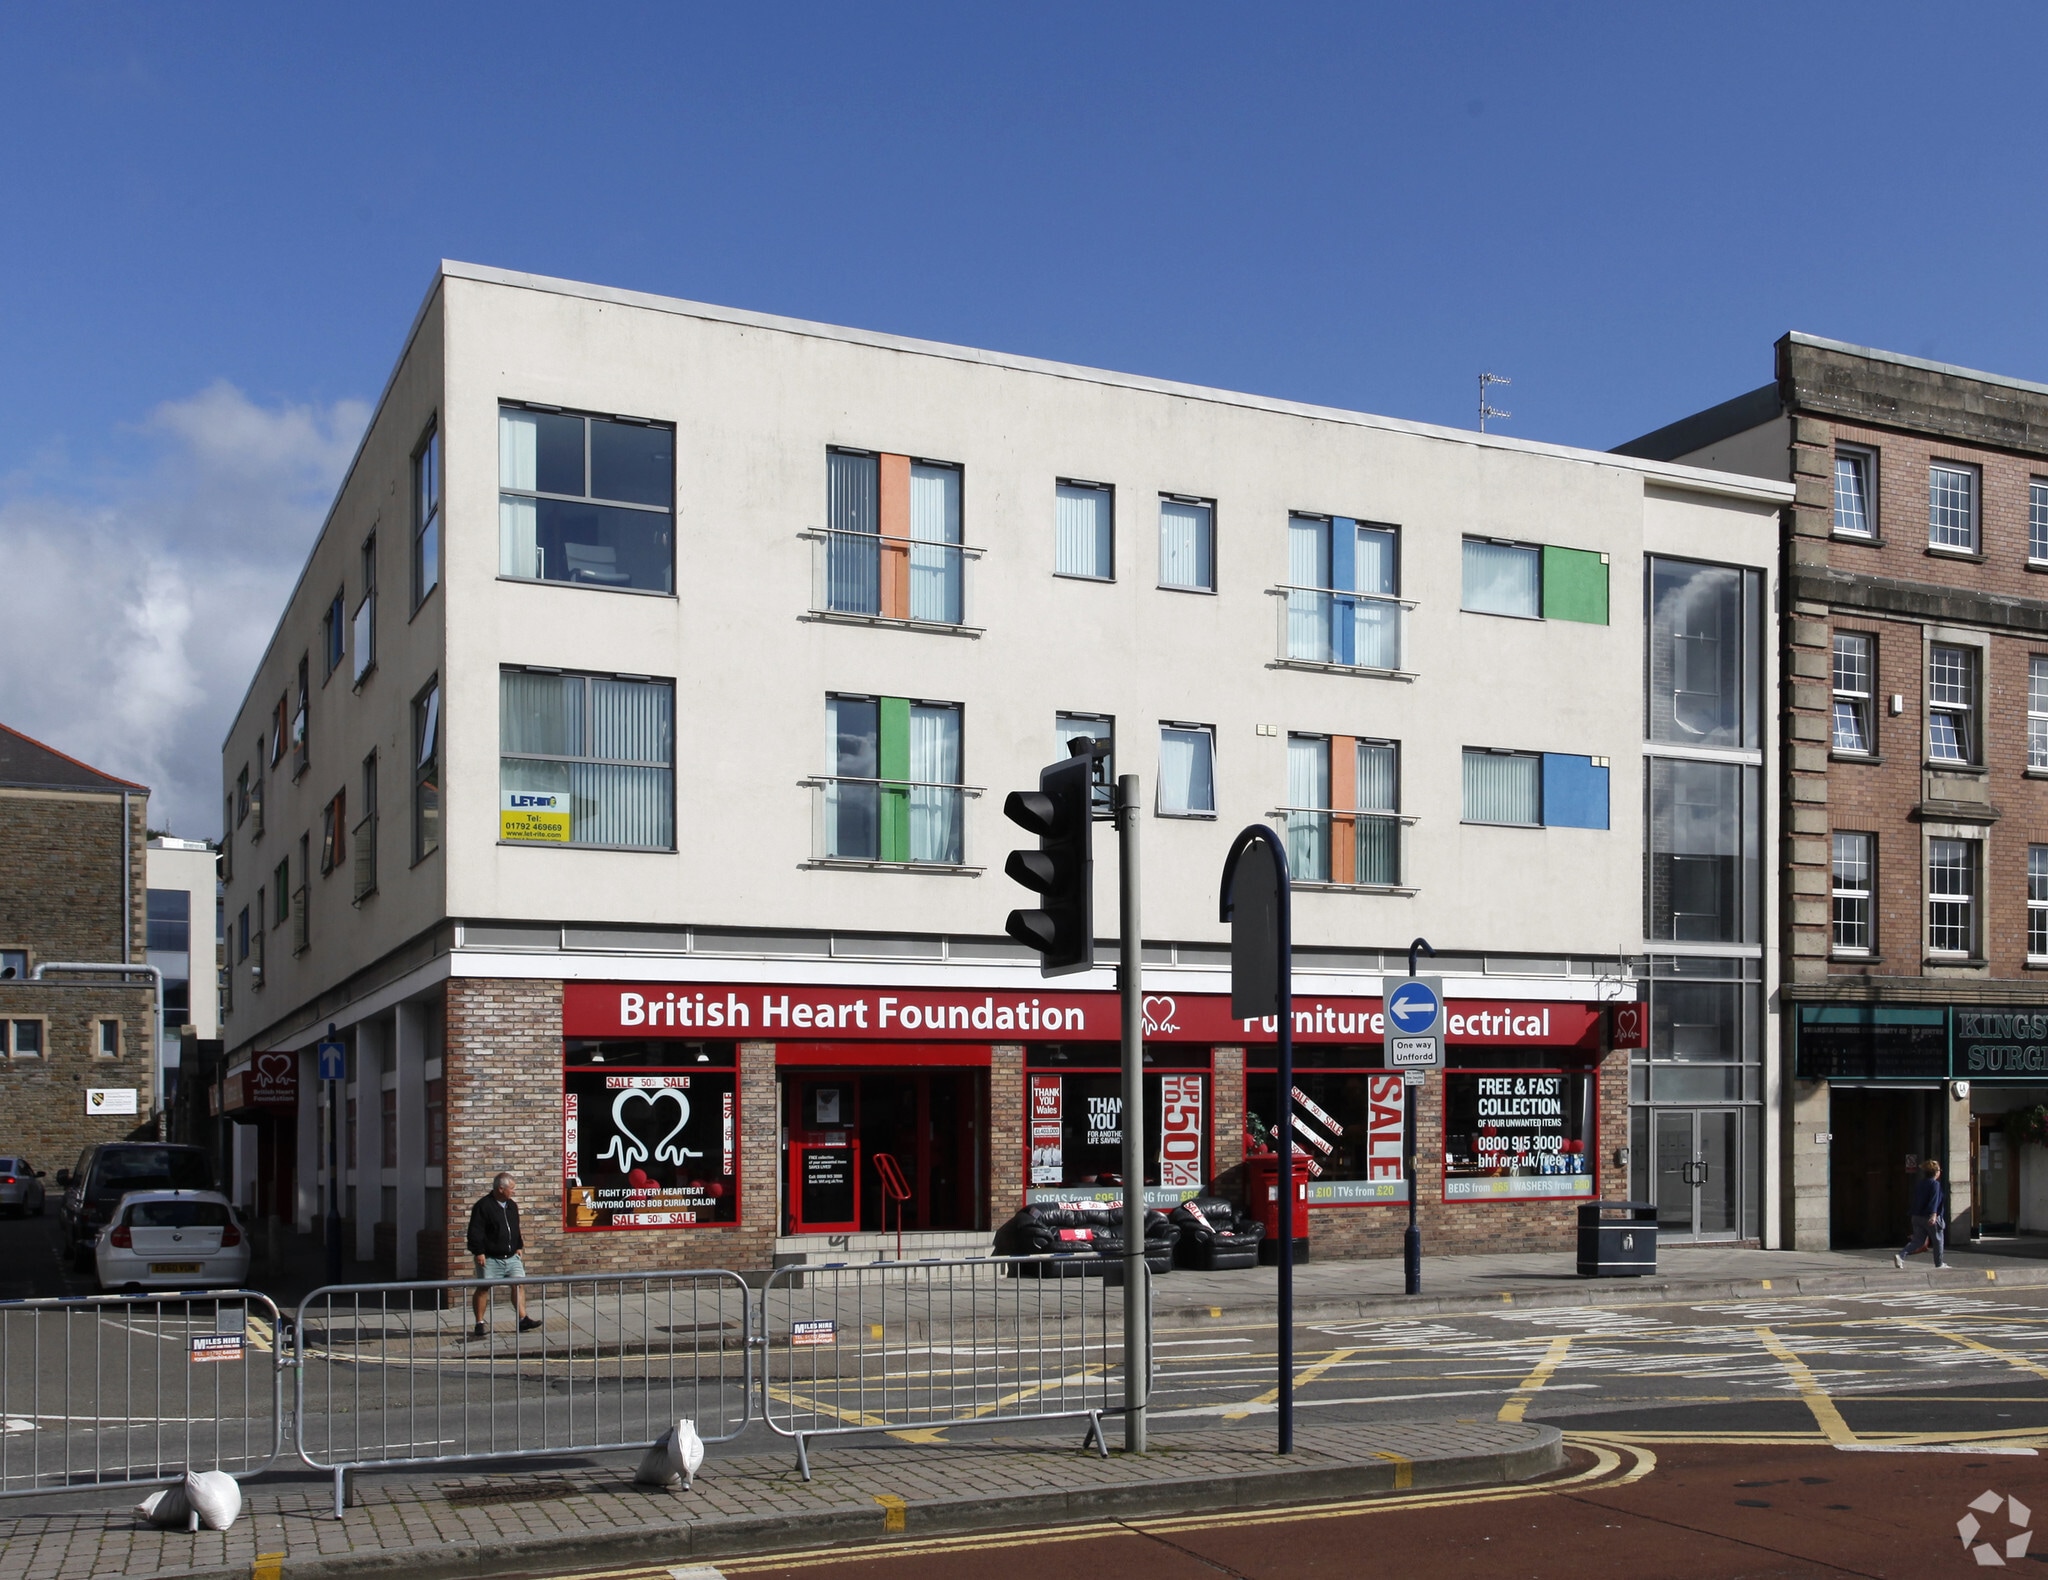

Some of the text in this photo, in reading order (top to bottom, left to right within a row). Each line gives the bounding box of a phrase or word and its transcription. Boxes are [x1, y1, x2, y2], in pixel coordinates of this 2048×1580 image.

[526, 814, 542, 822] Tel:
[505, 822, 562, 832] 01792 469669
[619, 992, 1085, 1031] British Heart Foundation
[1243, 1003, 1549, 1036] uniture lectrical
[1958, 1013, 2048, 1040] KINGS
[1396, 1041, 1432, 1050] One way
[1396, 1052, 1433, 1061] Unffordd
[607, 1077, 634, 1088] SALE
[663, 1077, 689, 1088] SALE
[1164, 1077, 1181, 1103] TO
[1183, 1076, 1199, 1103] UP
[1478, 1078, 1561, 1095] FREE & FAST
[1034, 1087, 1060, 1097] THANK
[566, 1094, 577, 1121] SALE
[723, 1093, 732, 1119] SALE
[1039, 1096, 1055, 1106] YOU
[1087, 1097, 1122, 1114] THAN
[1478, 1098, 1561, 1116] COLLECTION
[1036, 1105, 1058, 1114] Wales
[1291, 1087, 1309, 1106] SALE
[1323, 1116, 1343, 1135] SALE
[1087, 1113, 1117, 1130] YOU
[1369, 1076, 1402, 1181] SALE
[1478, 1118, 1562, 1128] OF YOUR UNWANTED ITEMS
[1087, 1130, 1122, 1138] FOR ANOTHE
[1313, 1137, 1334, 1155] SALE
[1478, 1135, 1563, 1151] 0800 915 3000
[566, 1151, 577, 1179] SALE
[723, 1148, 732, 1175] SALE
[1307, 1160, 1323, 1176] ALE
[1478, 1151, 1562, 1169] bhf.org.uk/free
[1163, 1161, 1174, 1185] OFF
[598, 1187, 704, 1197] FIGHT FOR EVERY HEARTBEAT
[1316, 1187, 1332, 1198] £10
[1338, 1186, 1353, 1197] TVs
[1355, 1186, 1374, 1197] from
[1376, 1185, 1394, 1196] £20
[1448, 1182, 1470, 1193] BEDS
[1472, 1182, 1490, 1193] from
[1513, 1181, 1553, 1192] WASHERS
[1554, 1180, 1572, 1191] from
[625, 1200, 646, 1208] DROS
[647, 1199, 663, 1208] BOB
[663, 1199, 690, 1207] CURIAD
[692, 1198, 716, 1206] CALON
[1035, 1194, 1067, 1203] SOFAS
[1069, 1193, 1092, 1202] from
[1094, 1193, 1114, 1201] £95
[1157, 1192, 1178, 1202] from
[1058, 1202, 1083, 1210] SALE
[1106, 1201, 1123, 1209] SAL
[1185, 1201, 1203, 1218] SALE
[613, 1214, 640, 1225] SALE
[669, 1212, 695, 1223] SALE
[794, 1322, 817, 1334] MILES
[193, 1336, 241, 1350] MILES HIRE
